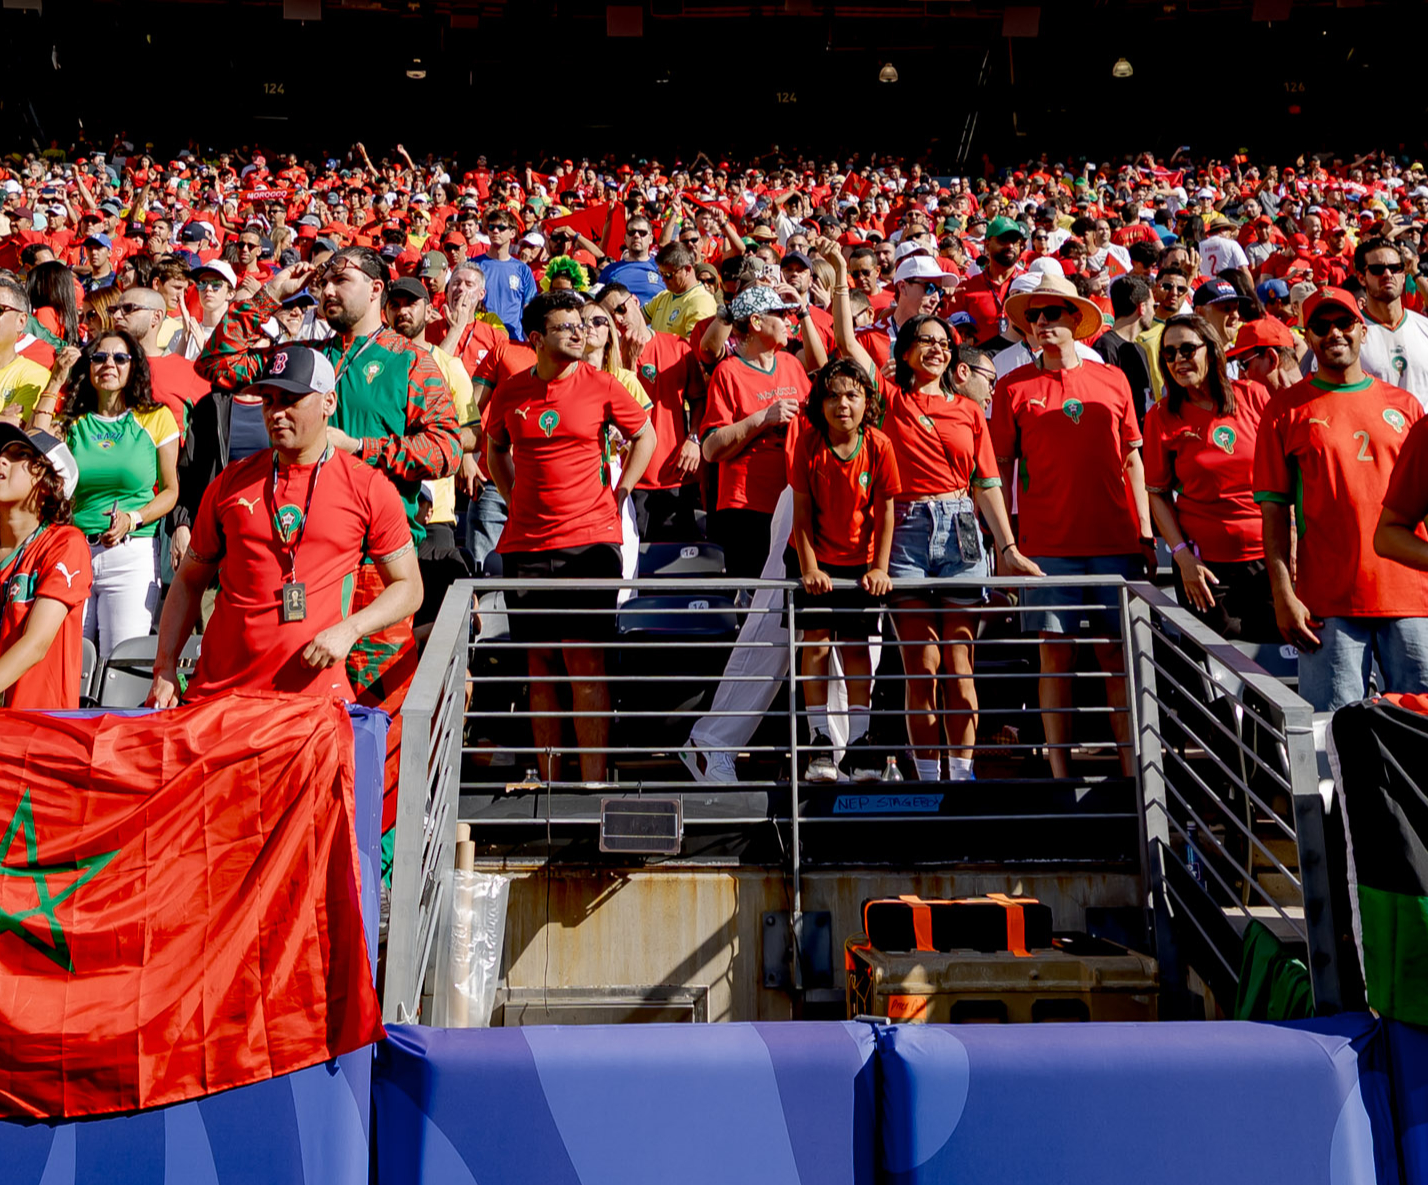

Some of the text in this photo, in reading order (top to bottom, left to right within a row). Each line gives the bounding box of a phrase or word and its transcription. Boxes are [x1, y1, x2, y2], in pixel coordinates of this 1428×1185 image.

[263, 82, 285, 95] 124
[776, 91, 797, 104] 124
[247, 189, 288, 200] MOROCCO
[1208, 254, 1219, 277] 2
[272, 350, 288, 375] B
[1353, 430, 1374, 461] 2
[684, 548, 695, 557] 14
